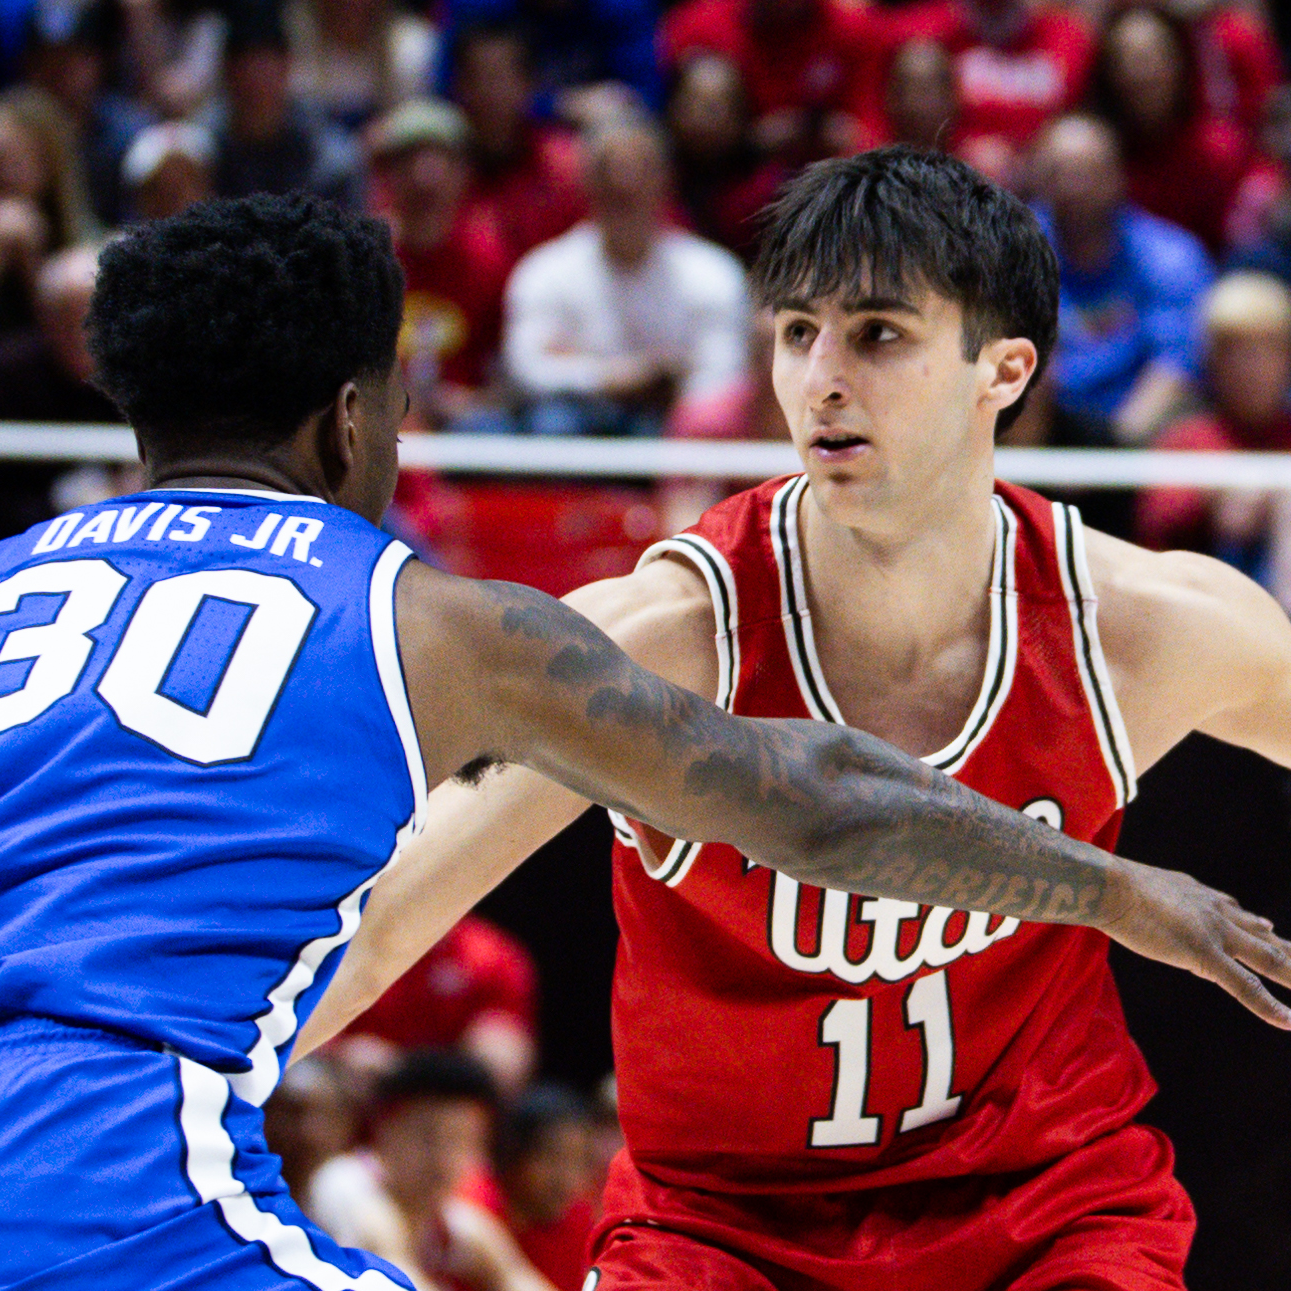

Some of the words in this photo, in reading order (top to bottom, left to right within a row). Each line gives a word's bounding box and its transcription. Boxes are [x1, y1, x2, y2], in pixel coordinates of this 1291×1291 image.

[30, 501, 222, 556] DAVIS
[229, 512, 325, 569] JR.
[742, 797, 1065, 984] Uta
[809, 968, 964, 1149] 11
